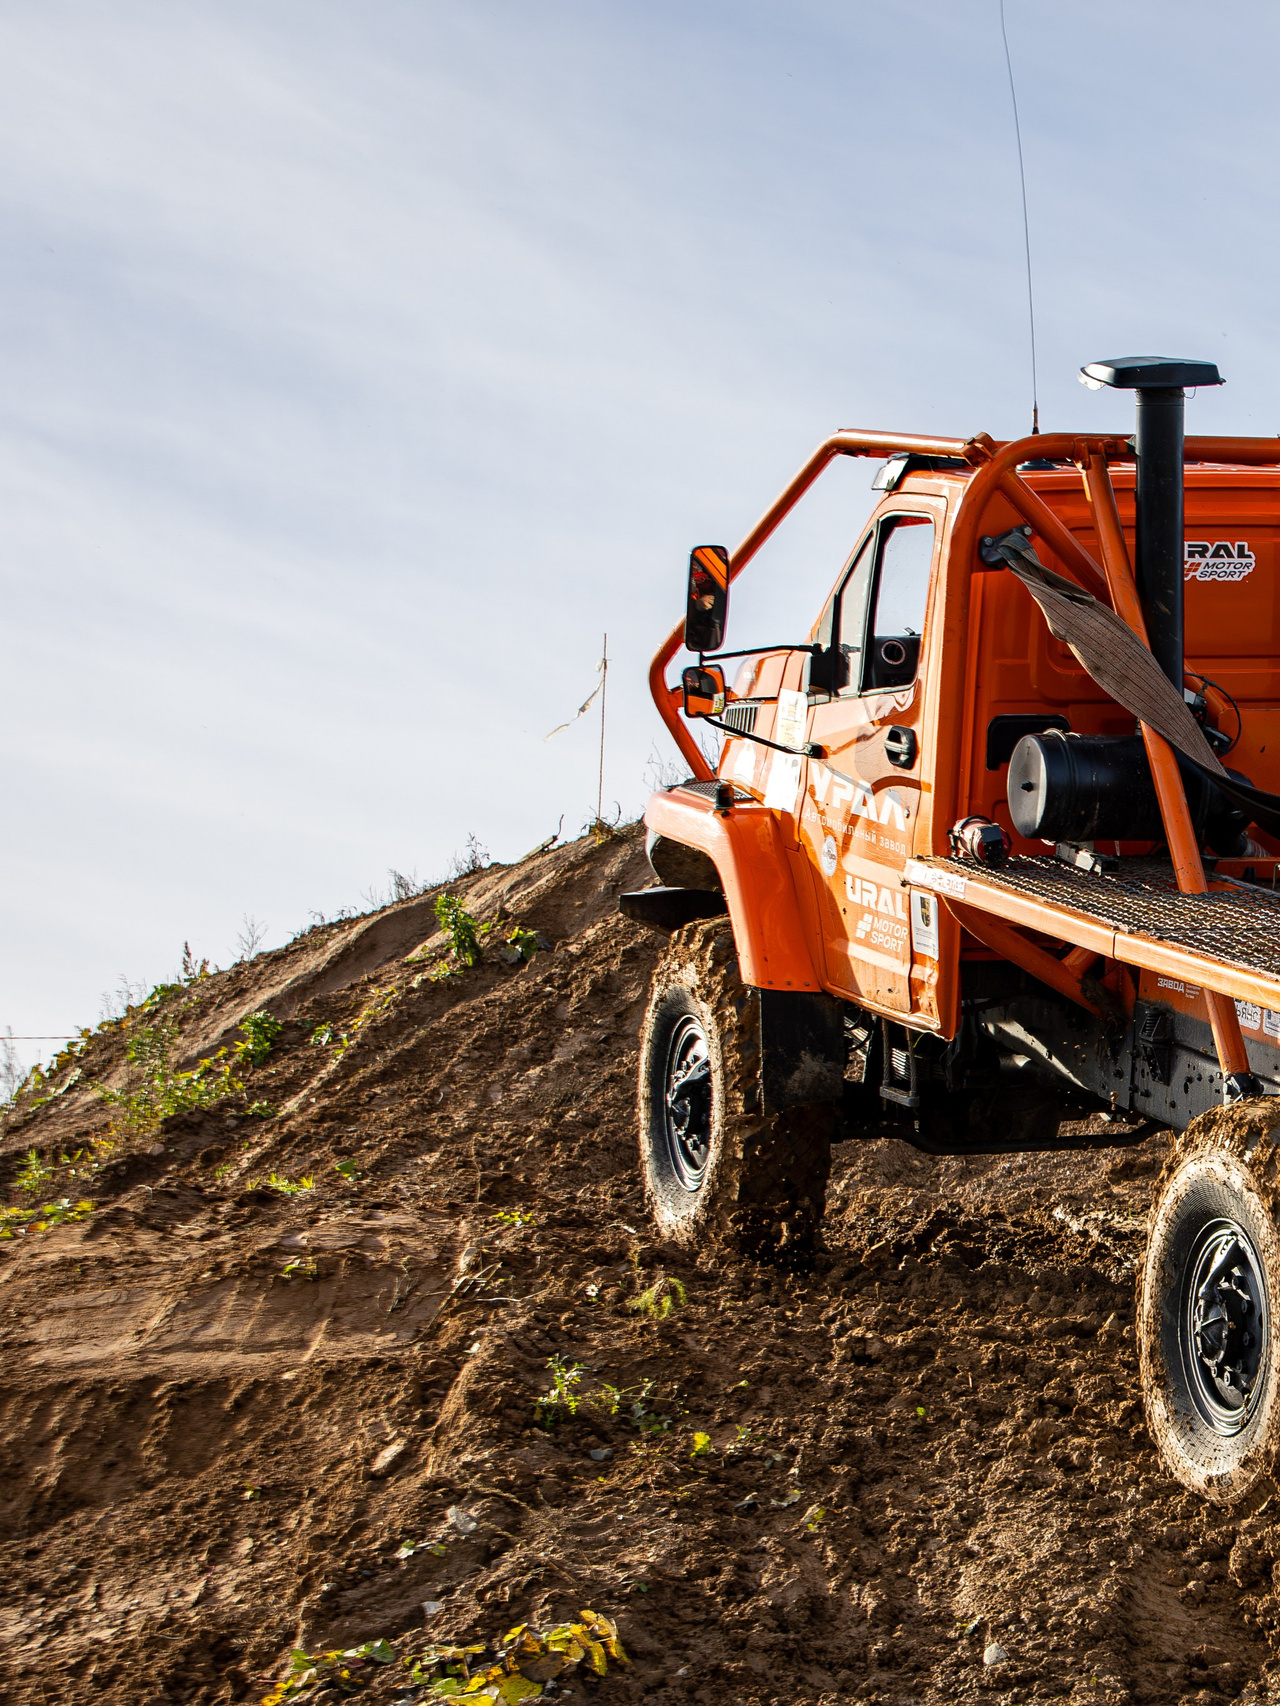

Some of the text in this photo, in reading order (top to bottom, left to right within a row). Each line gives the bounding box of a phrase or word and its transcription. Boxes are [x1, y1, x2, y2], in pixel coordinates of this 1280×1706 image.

[1187, 544, 1254, 559] RAL
[1199, 571, 1246, 579] SPORT
[1203, 562, 1253, 570] MOTOR
[810, 761, 907, 833] УРАЛ
[846, 874, 908, 922] URAL
[873, 917, 909, 939] MOTOR
[870, 931, 905, 953] SPORT
[1157, 977, 1185, 993] ЗАВОД
